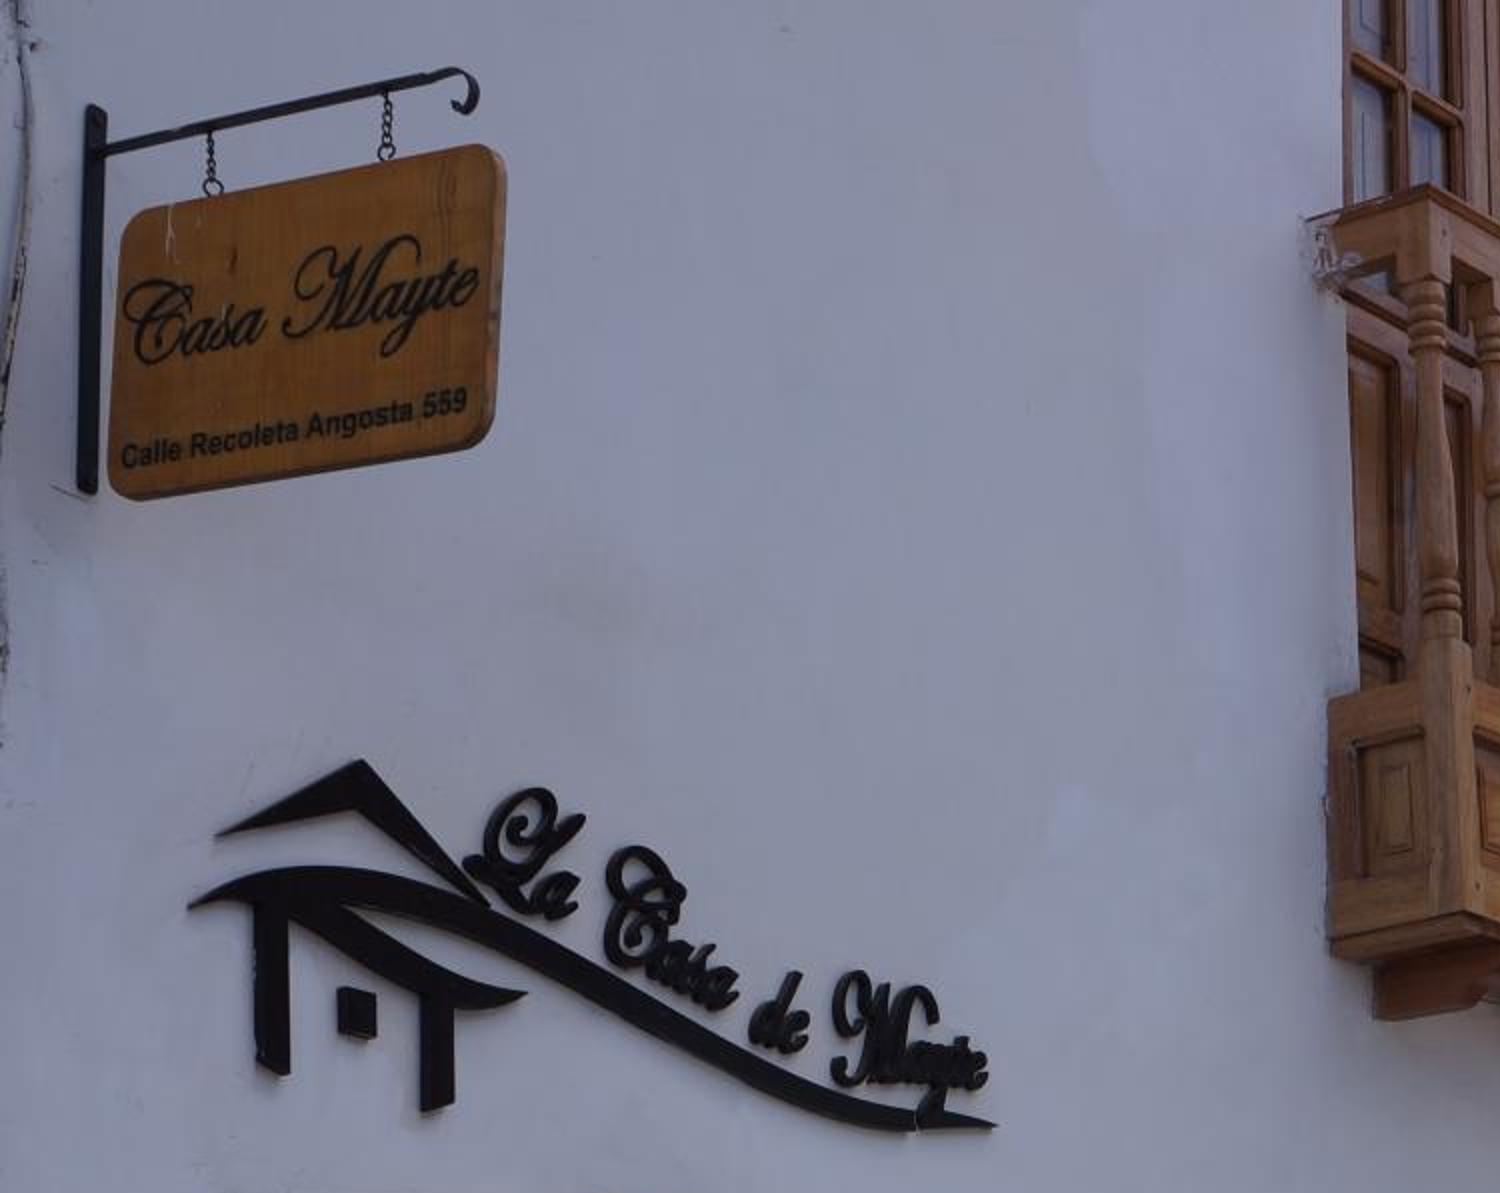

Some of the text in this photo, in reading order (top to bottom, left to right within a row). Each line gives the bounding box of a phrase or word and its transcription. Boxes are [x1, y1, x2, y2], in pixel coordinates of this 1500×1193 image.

[124, 234, 480, 364] Casa Mayte
[122, 387, 468, 469] Calle Recoleta Angosta 559
[462, 787, 586, 920] La
[604, 845, 740, 1012] Casa
[748, 971, 810, 1054] de
